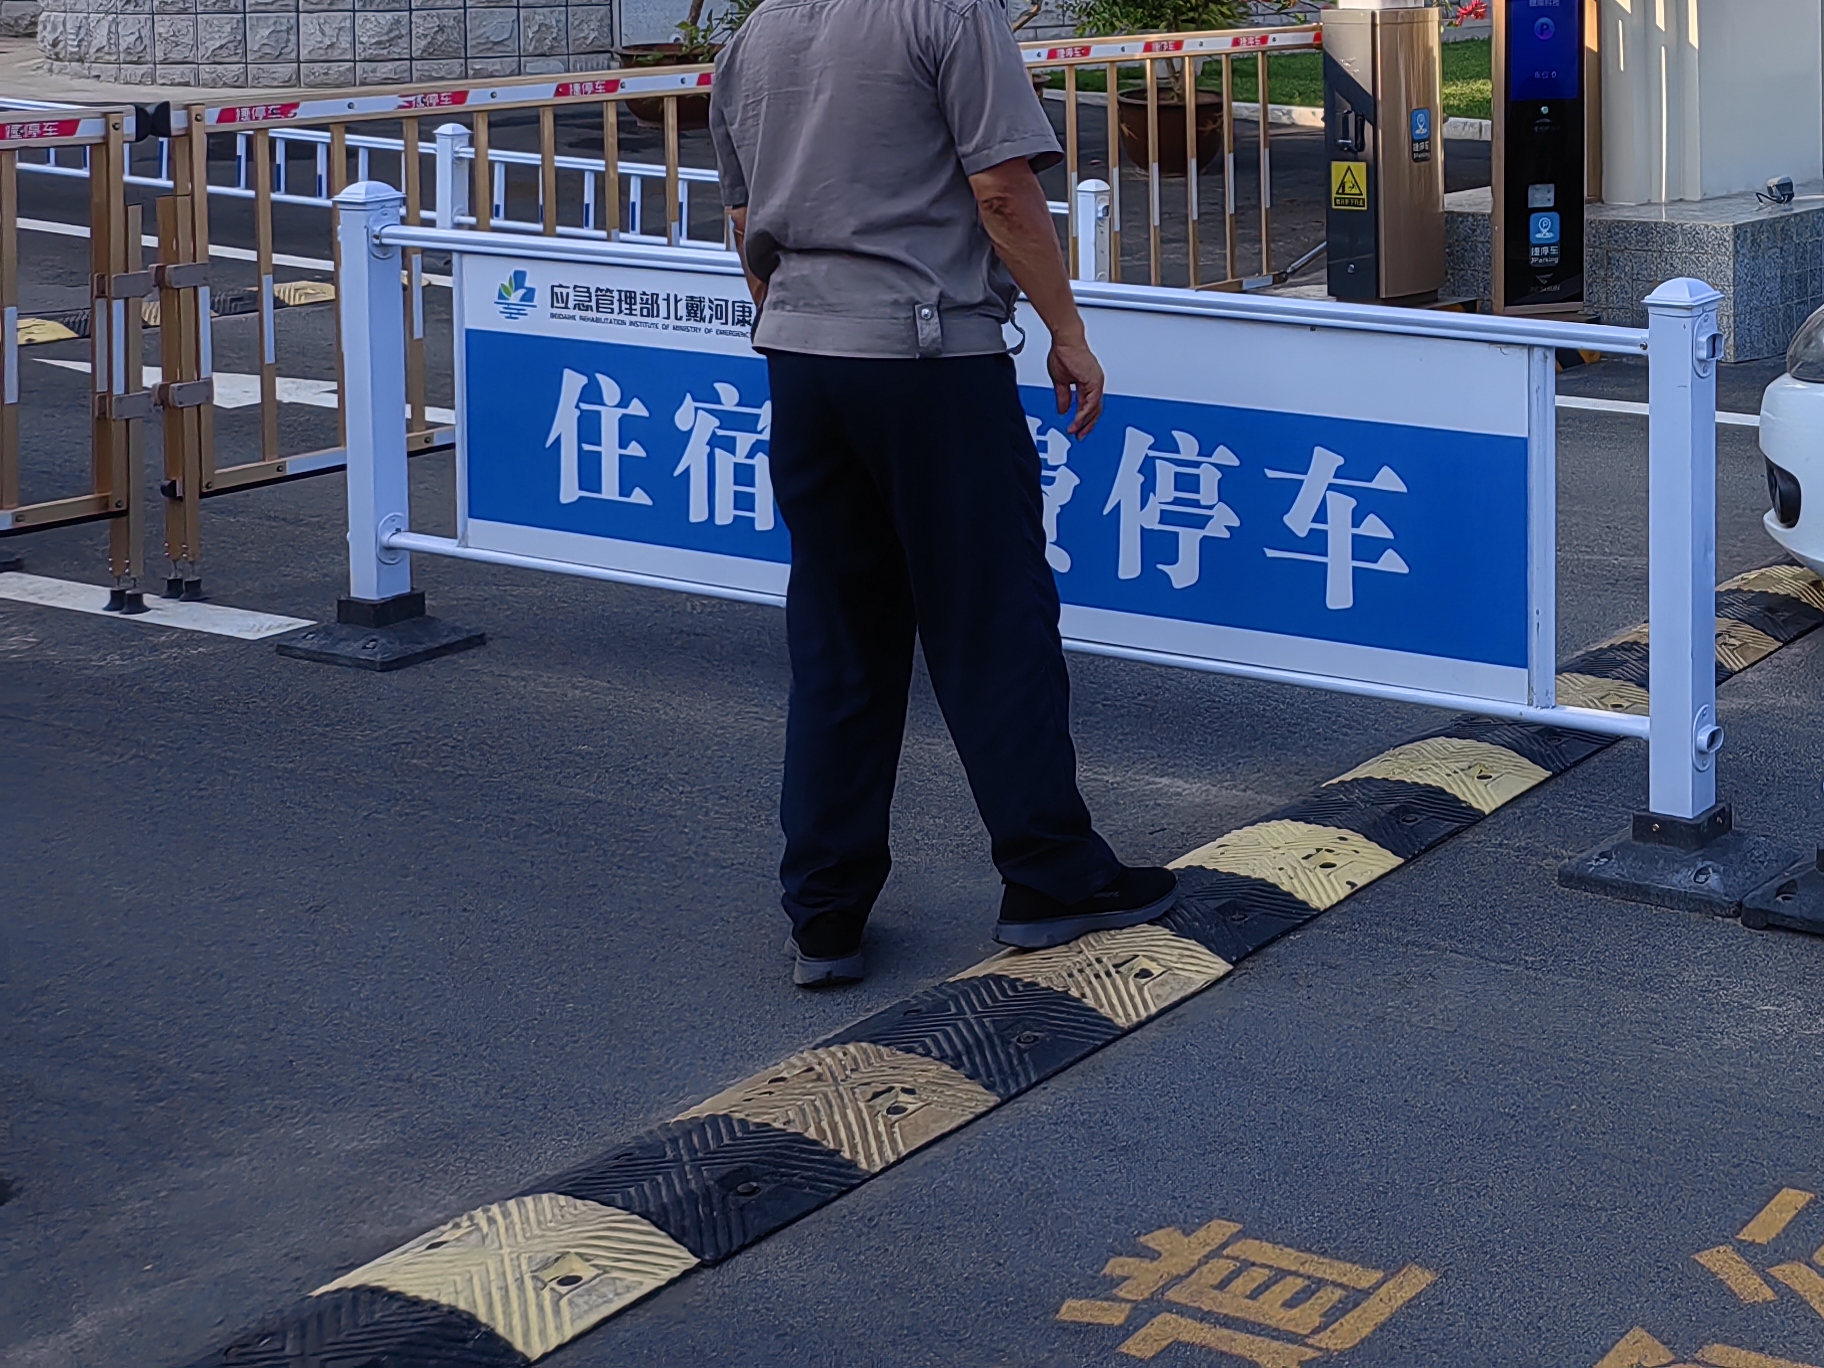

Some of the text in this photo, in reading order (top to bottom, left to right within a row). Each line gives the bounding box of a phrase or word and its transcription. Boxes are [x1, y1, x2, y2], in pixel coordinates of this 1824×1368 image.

[579, 314, 627, 326] REHABILITATION
[628, 319, 660, 330] INSTITUTE
[661, 322, 670, 331] OF
[672, 324, 702, 334] MINISTRY
[704, 327, 714, 336] OF
